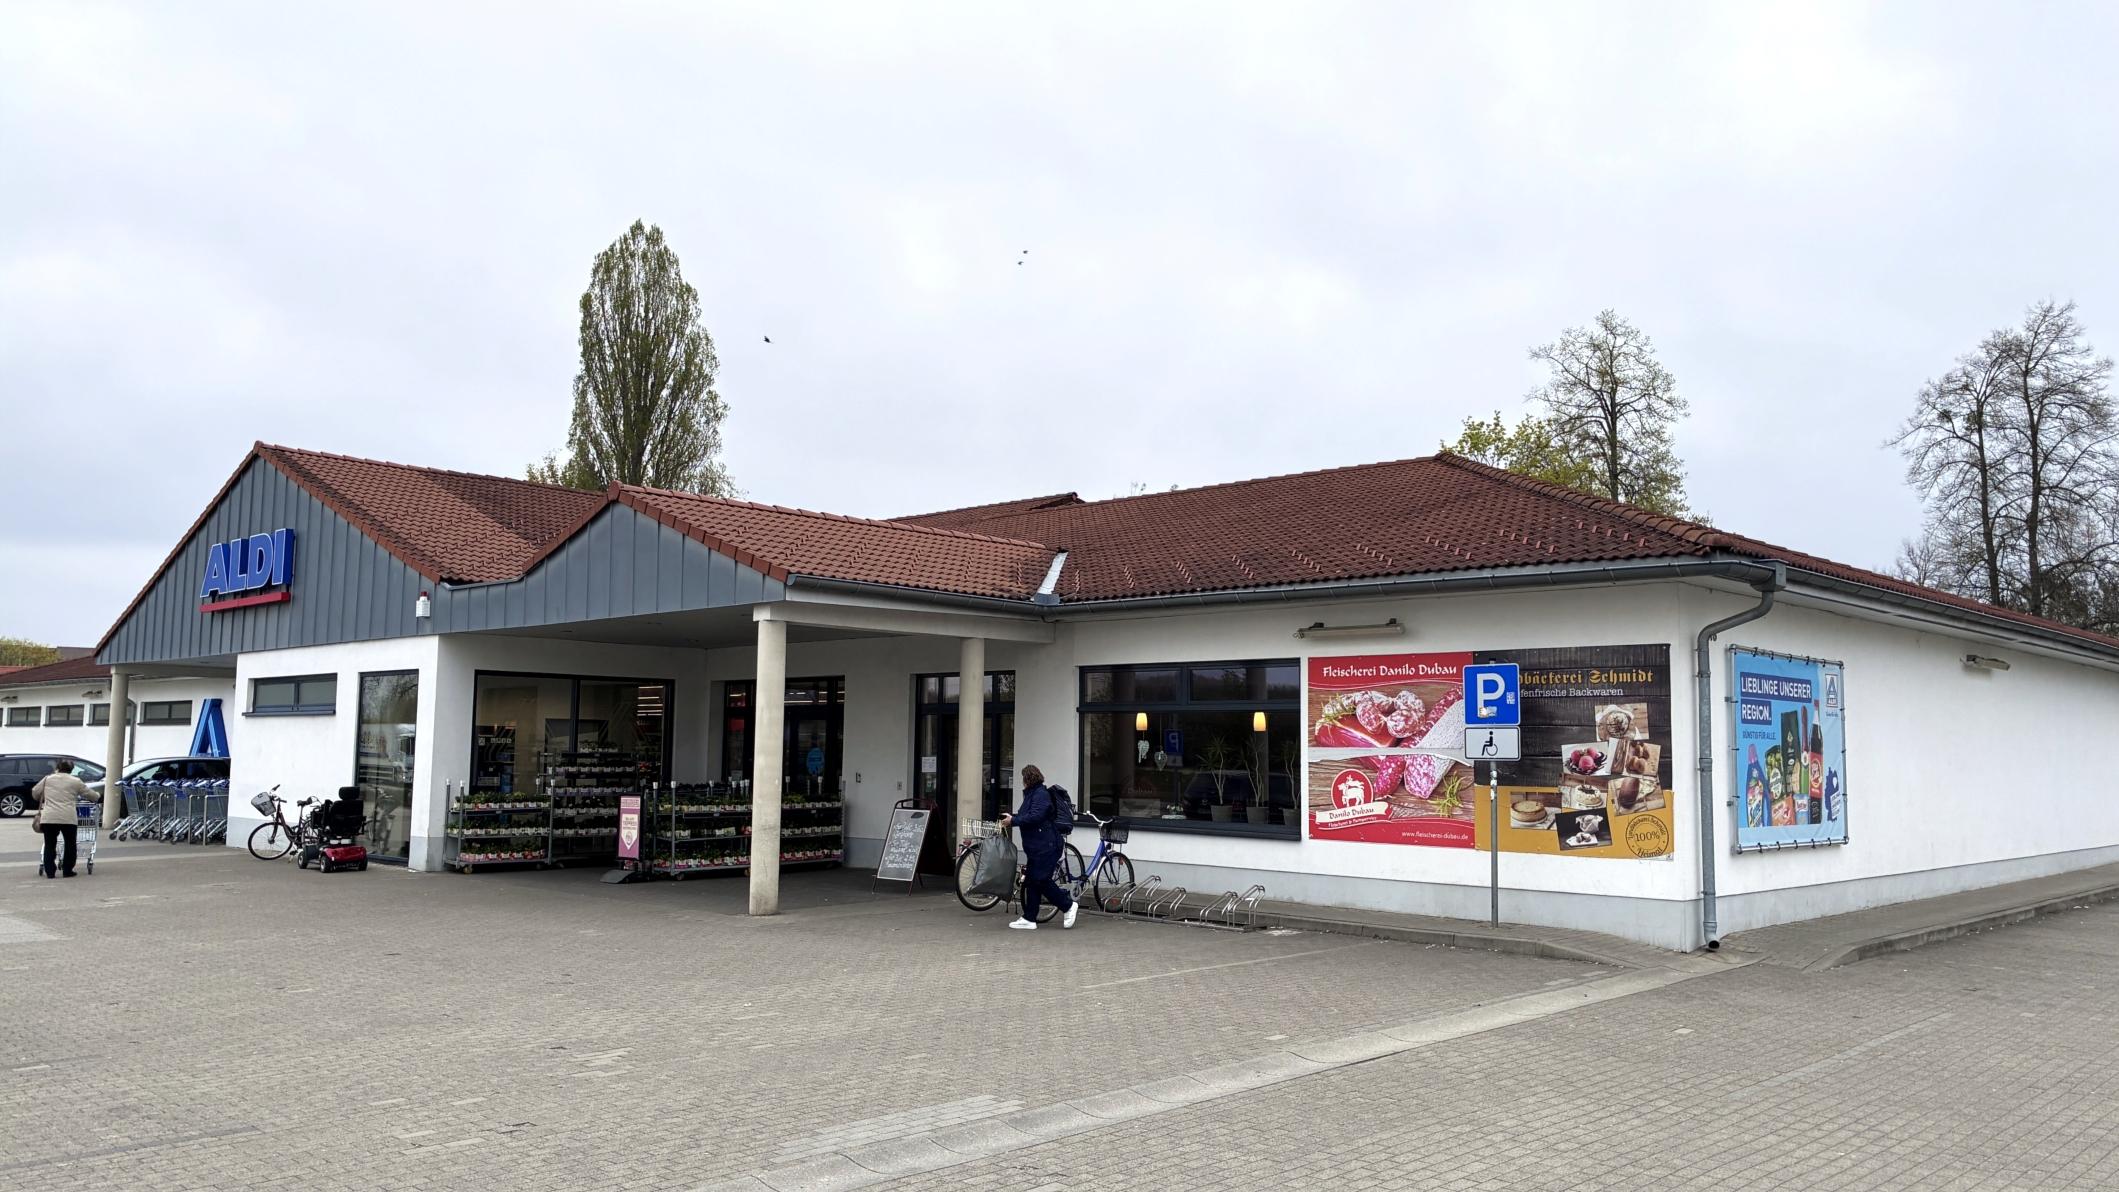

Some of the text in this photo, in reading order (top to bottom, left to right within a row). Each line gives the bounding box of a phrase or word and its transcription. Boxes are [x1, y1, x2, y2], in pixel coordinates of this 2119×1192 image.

[200, 527, 293, 598] ALDI
[1322, 662, 1457, 677] Fleischerei Danilo Dubau
[1589, 669, 1654, 686] Schmidt
[1477, 672, 1506, 718] P
[1569, 687, 1624, 697] Backwaren
[1741, 677, 1811, 698] LIEBLINGE UNSERER
[1741, 703, 1772, 721] REGION.
[1328, 807, 1375, 820] Danilo Dubau
[1401, 831, 1469, 840] www.fleischerei-dubau.de
[1635, 830, 1661, 842] 100%
[1636, 846, 1664, 857] Heimat
